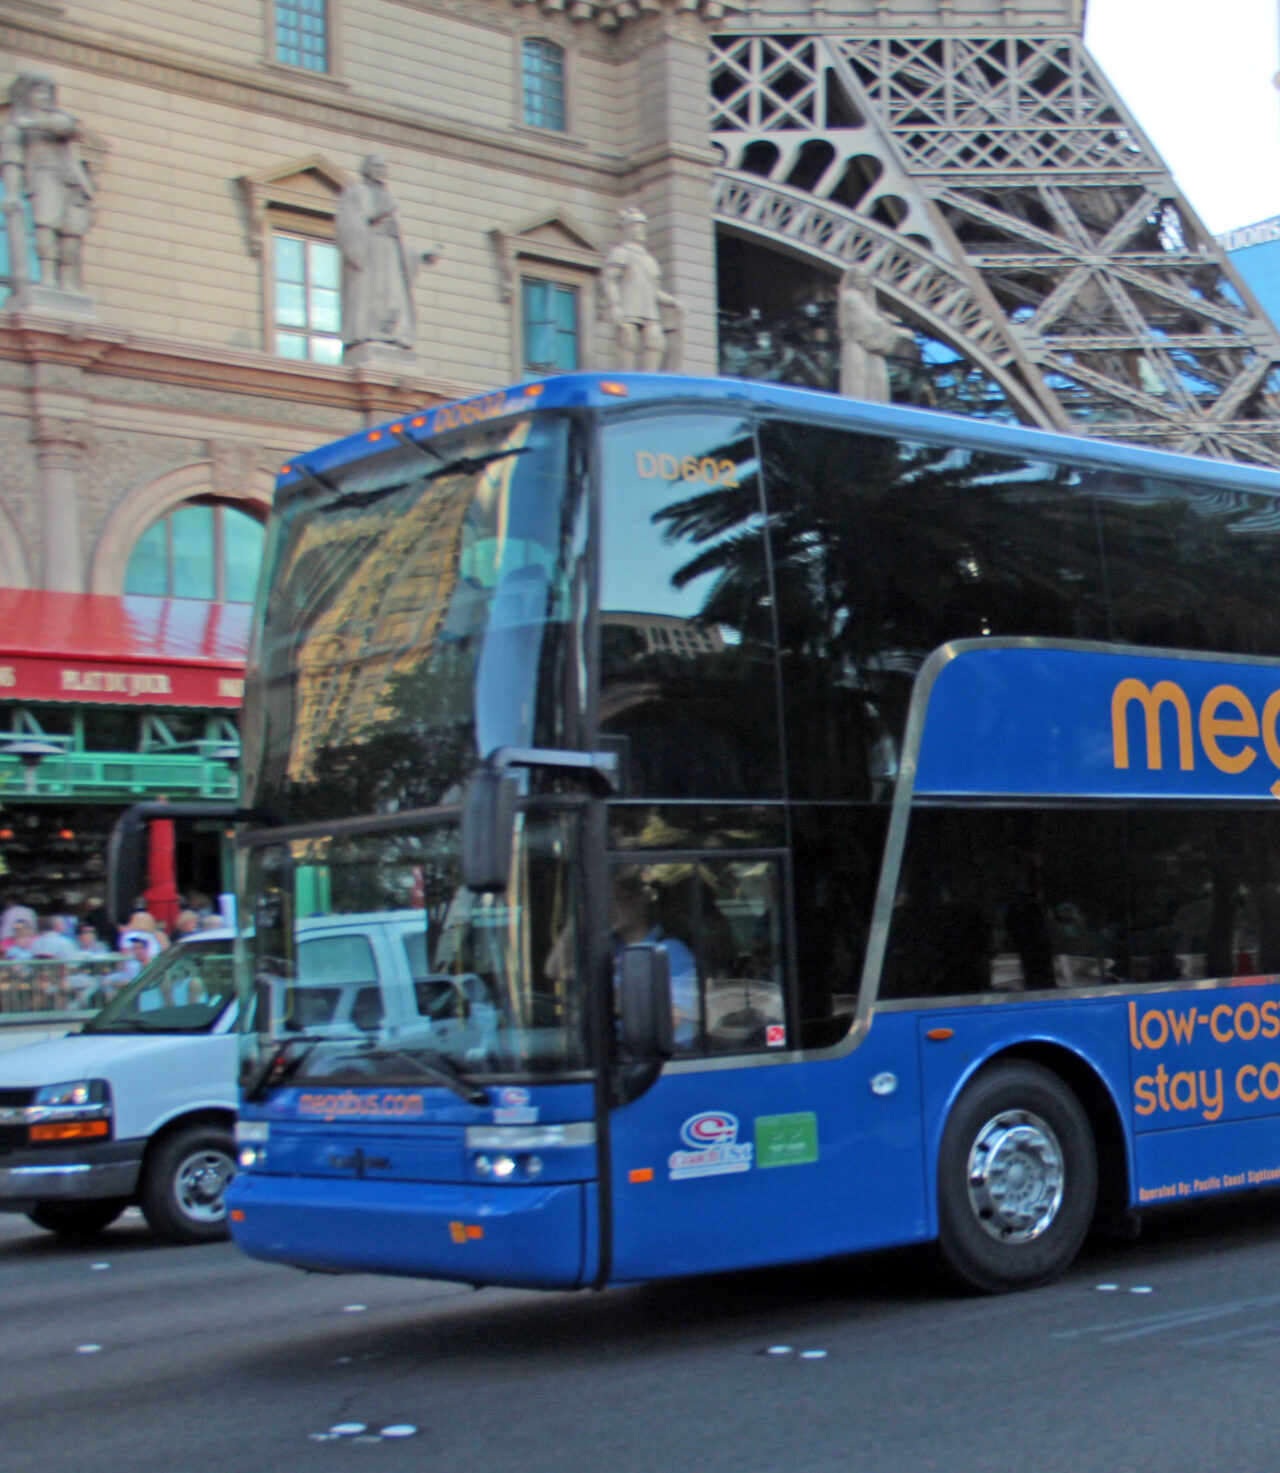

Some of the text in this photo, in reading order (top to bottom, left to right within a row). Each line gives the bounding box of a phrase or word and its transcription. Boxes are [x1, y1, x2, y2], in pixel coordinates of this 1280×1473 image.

[636, 451, 740, 488] DD602
[298, 1090, 425, 1122] megabus.com
[1134, 1063, 1223, 1120] stay
[1139, 1187, 1176, 1201] Operated
[1193, 1177, 1220, 1193] Pacific
